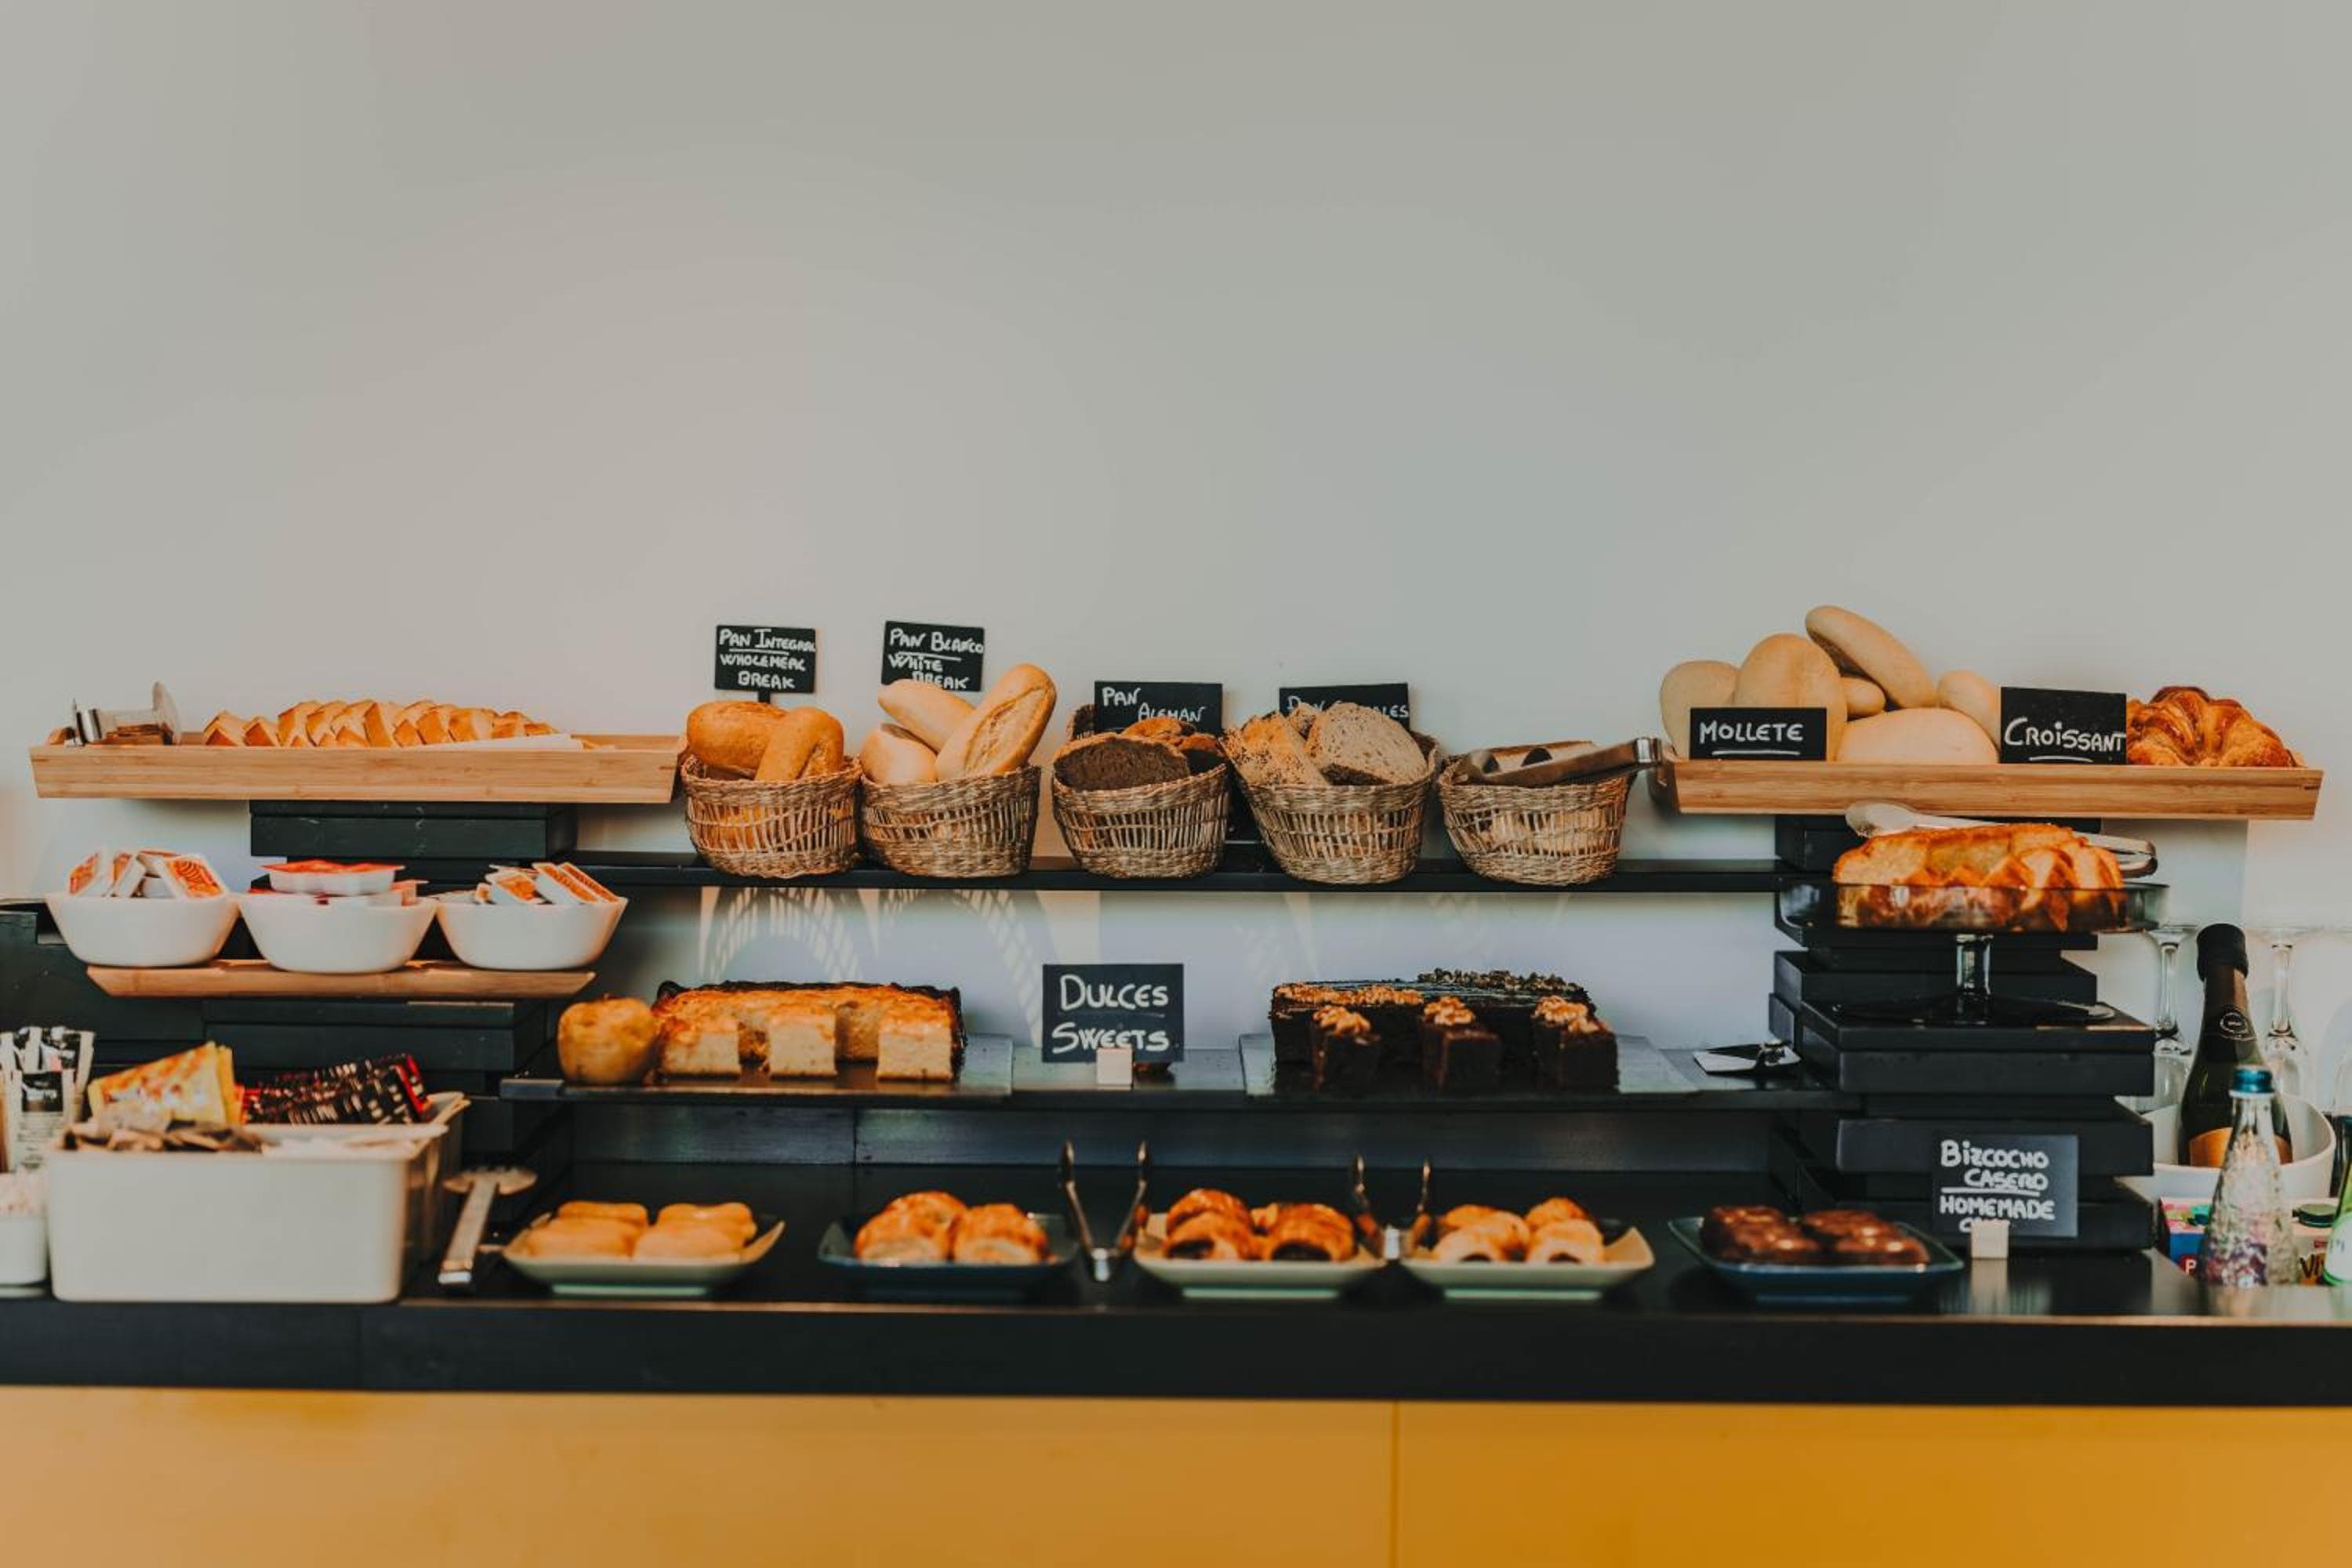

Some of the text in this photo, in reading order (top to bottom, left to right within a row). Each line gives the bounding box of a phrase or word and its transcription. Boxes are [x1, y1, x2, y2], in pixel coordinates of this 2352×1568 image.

[719, 628, 816, 652] PAN INTEGRAL
[890, 628, 926, 647] PAN
[1102, 686, 1142, 706] PAN
[1700, 720, 1803, 744] MOLLETE
[1060, 974, 1169, 1011] DULCES
[1051, 1022, 1170, 1054] SWEETS
[1940, 1196, 2055, 1220] HOMEMADE
